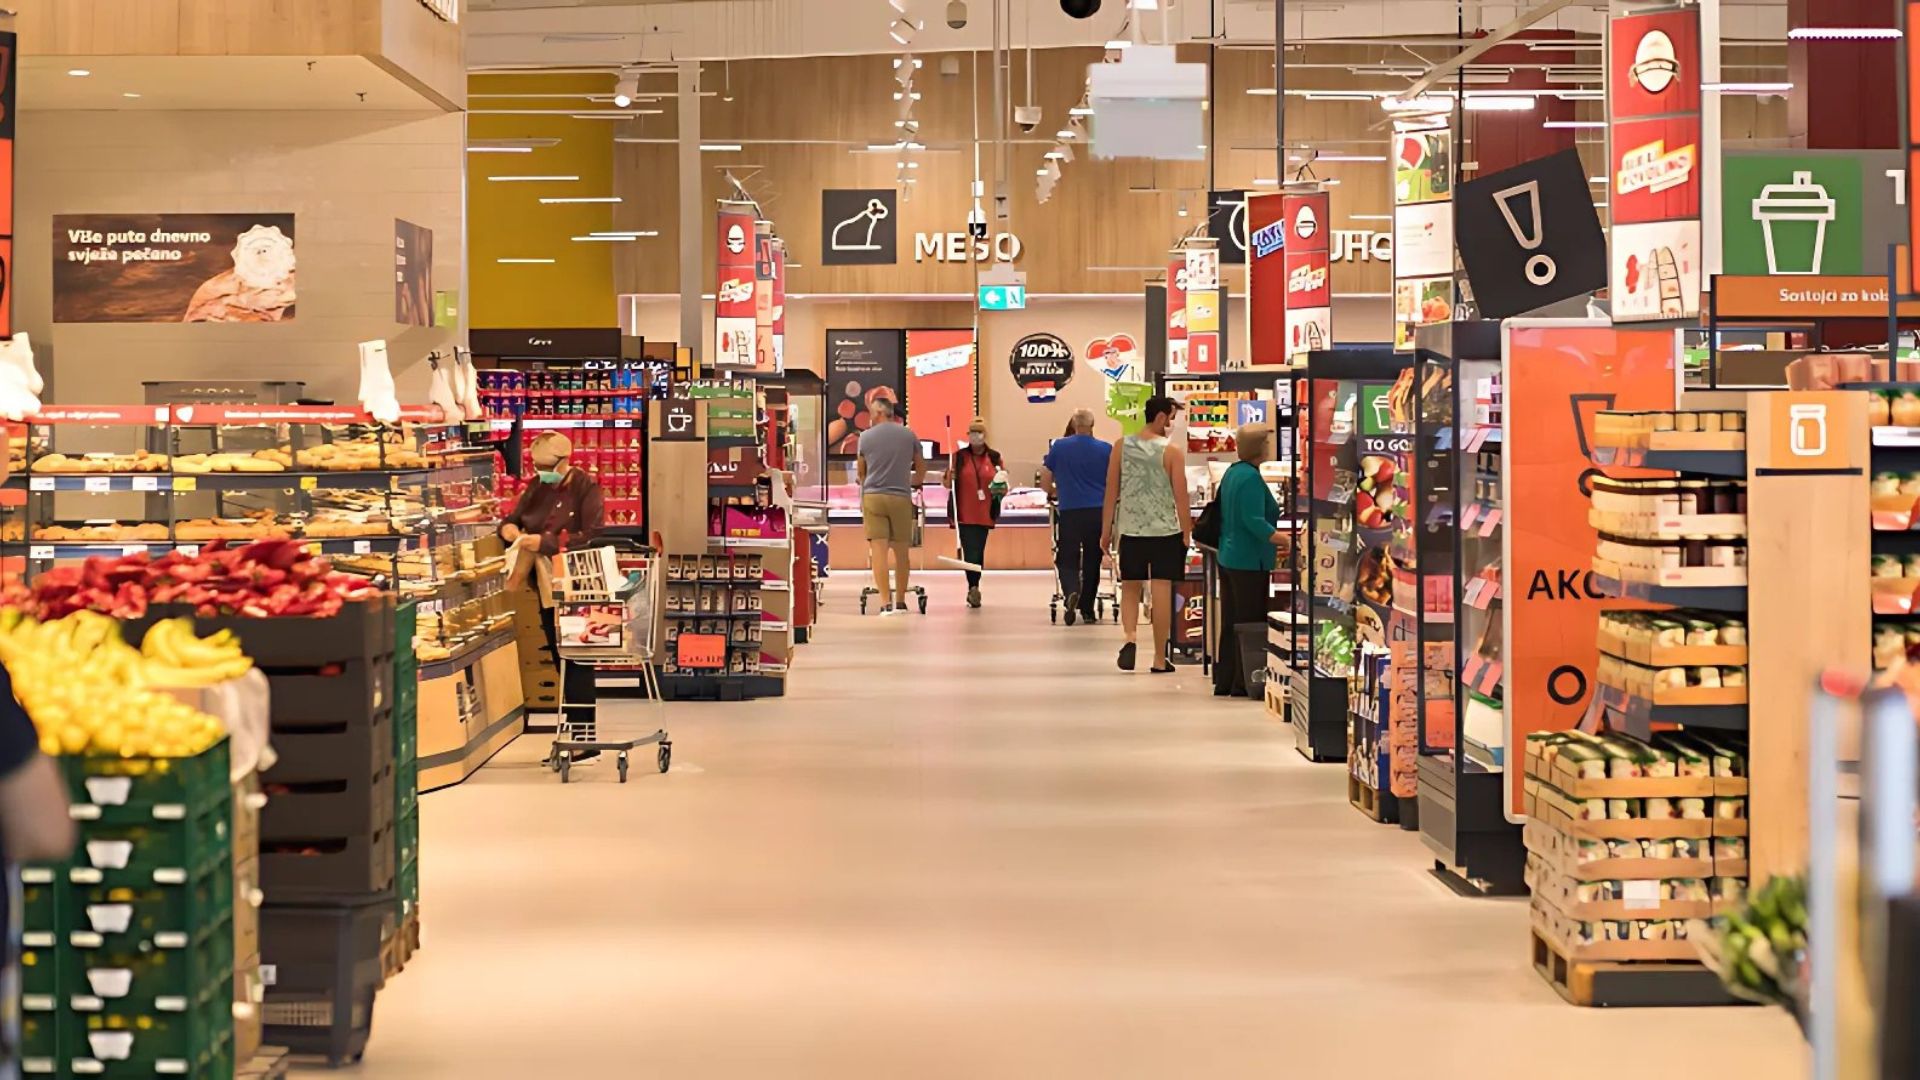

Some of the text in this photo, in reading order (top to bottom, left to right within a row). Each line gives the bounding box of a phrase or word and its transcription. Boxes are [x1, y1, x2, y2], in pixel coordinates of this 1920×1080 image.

[68, 228, 211, 246] Više puta dnevno
[914, 231, 1022, 263] MESO
[1020, 342, 1069, 359] 100%
[1365, 439, 1411, 452] TO GO
